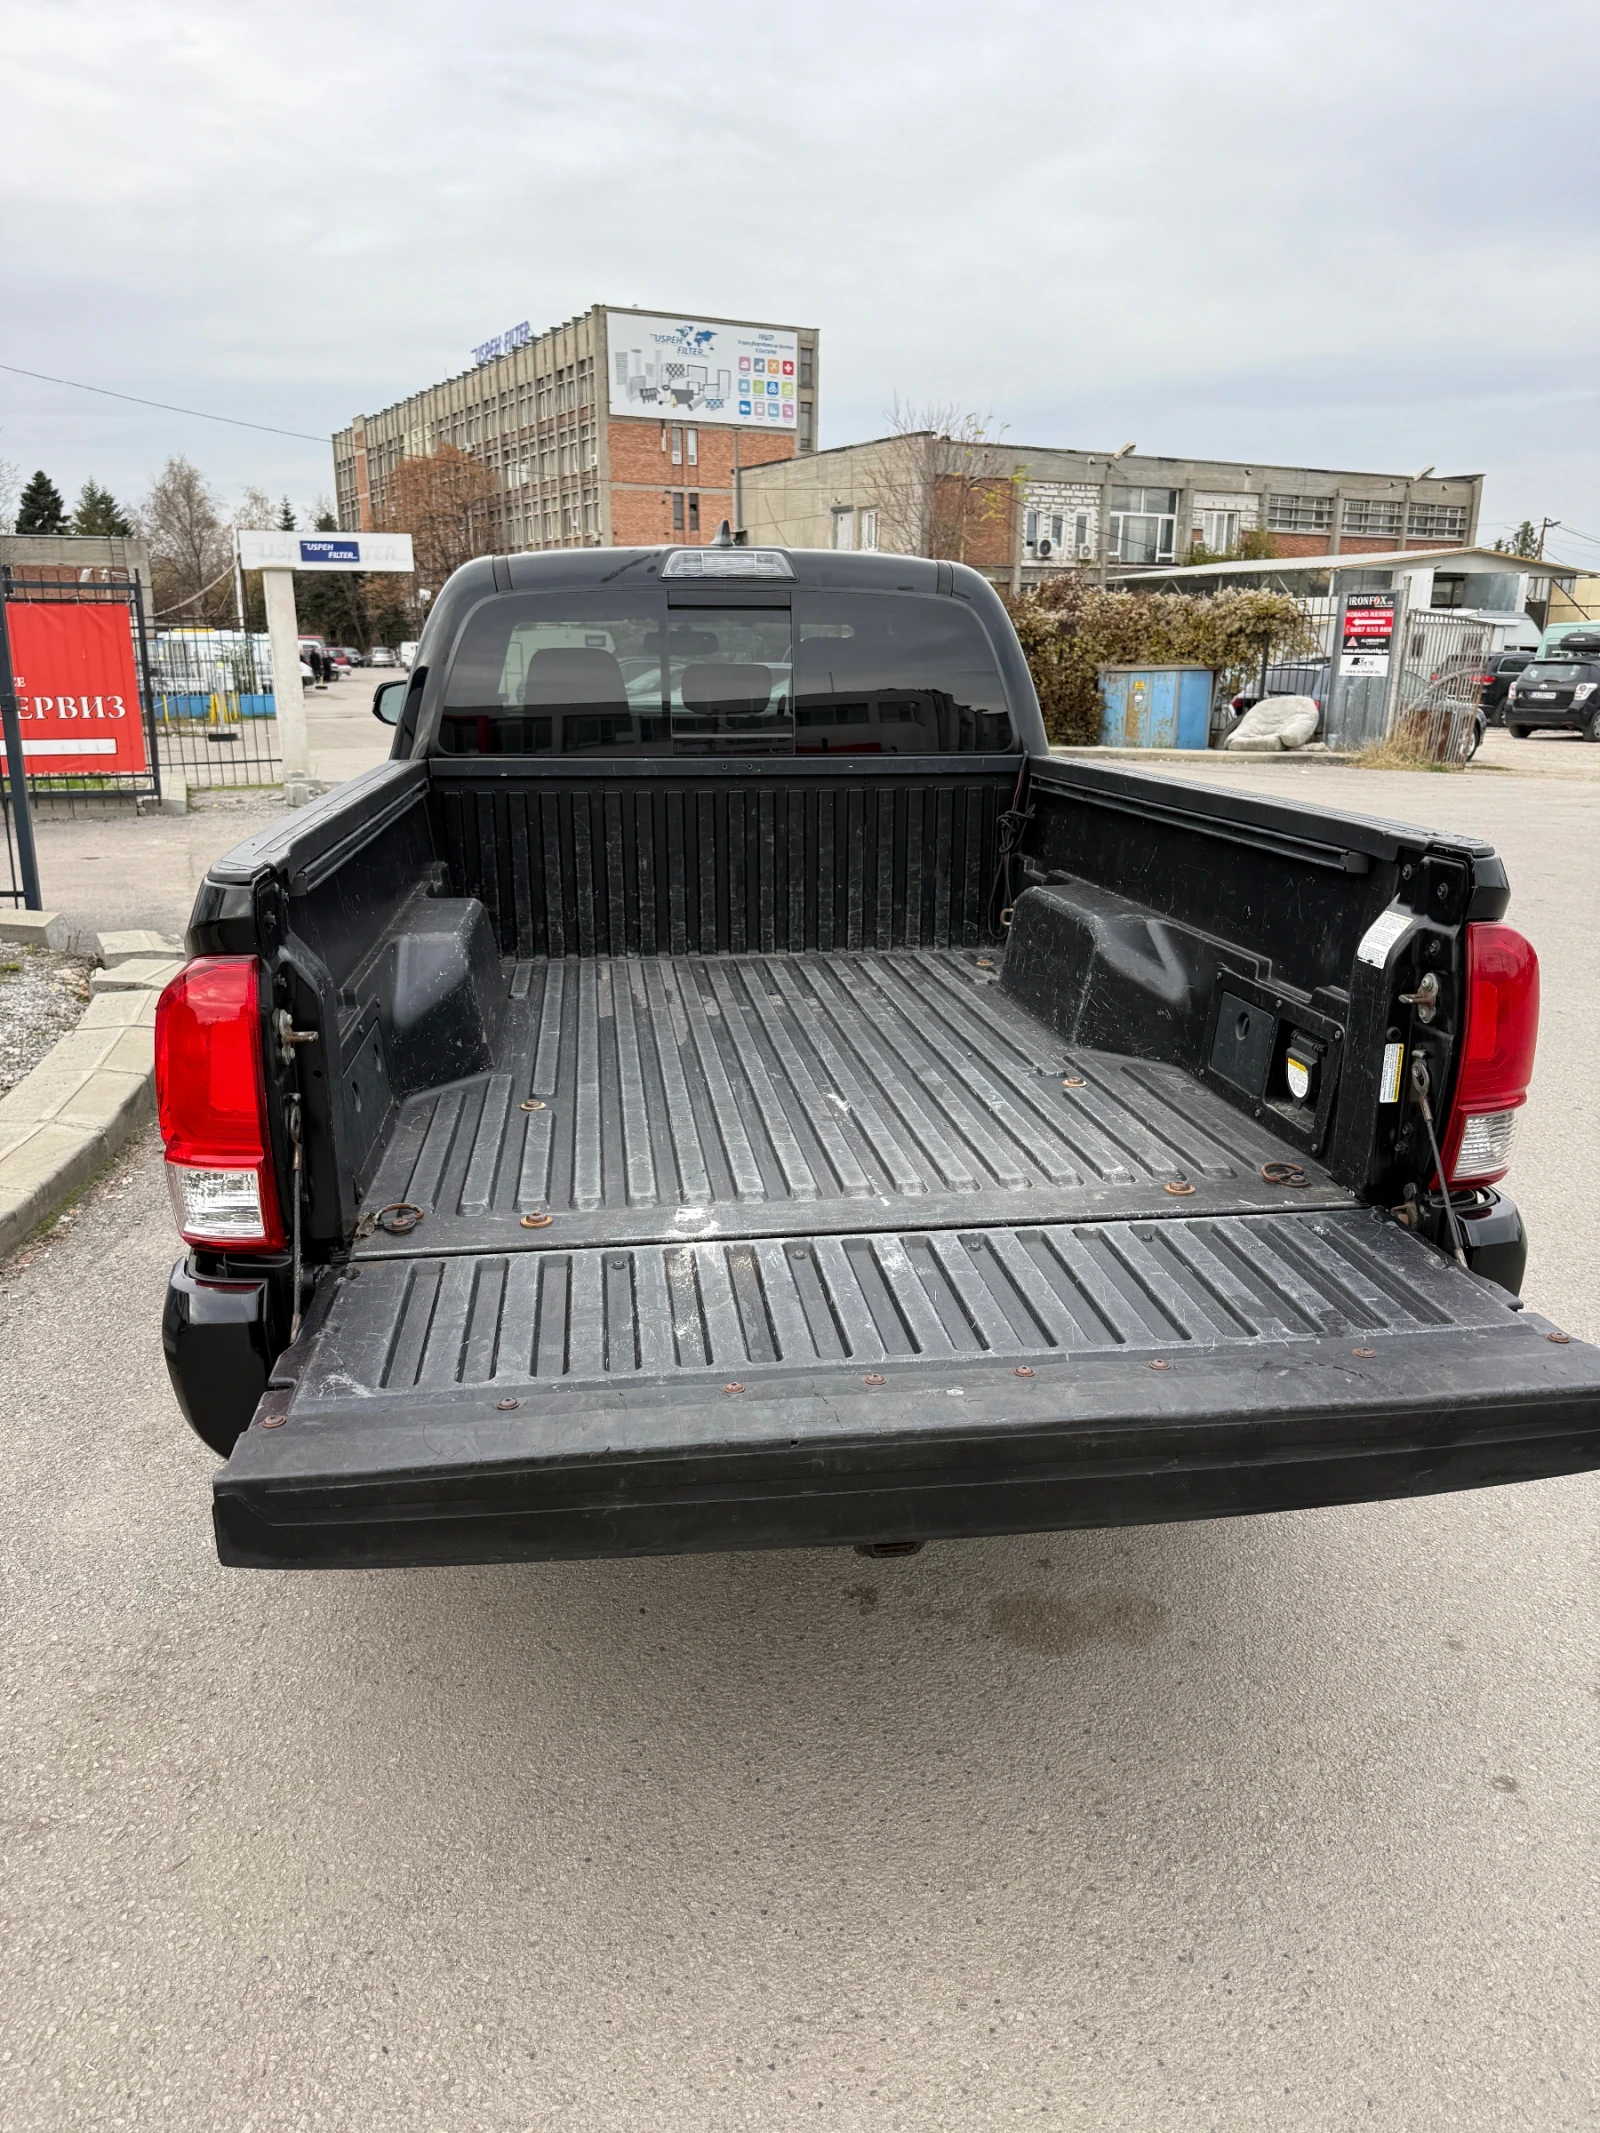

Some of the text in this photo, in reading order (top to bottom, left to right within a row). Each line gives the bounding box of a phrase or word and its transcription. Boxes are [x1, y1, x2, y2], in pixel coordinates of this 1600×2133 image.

[651, 334, 683, 344] USPEH
[677, 346, 706, 356] FILTER
[302, 543, 334, 551] USPEH
[328, 551, 357, 559] FILTER
[1349, 596, 1387, 605] IRONFOX
[0, 695, 127, 720] ЕРВИЗ
